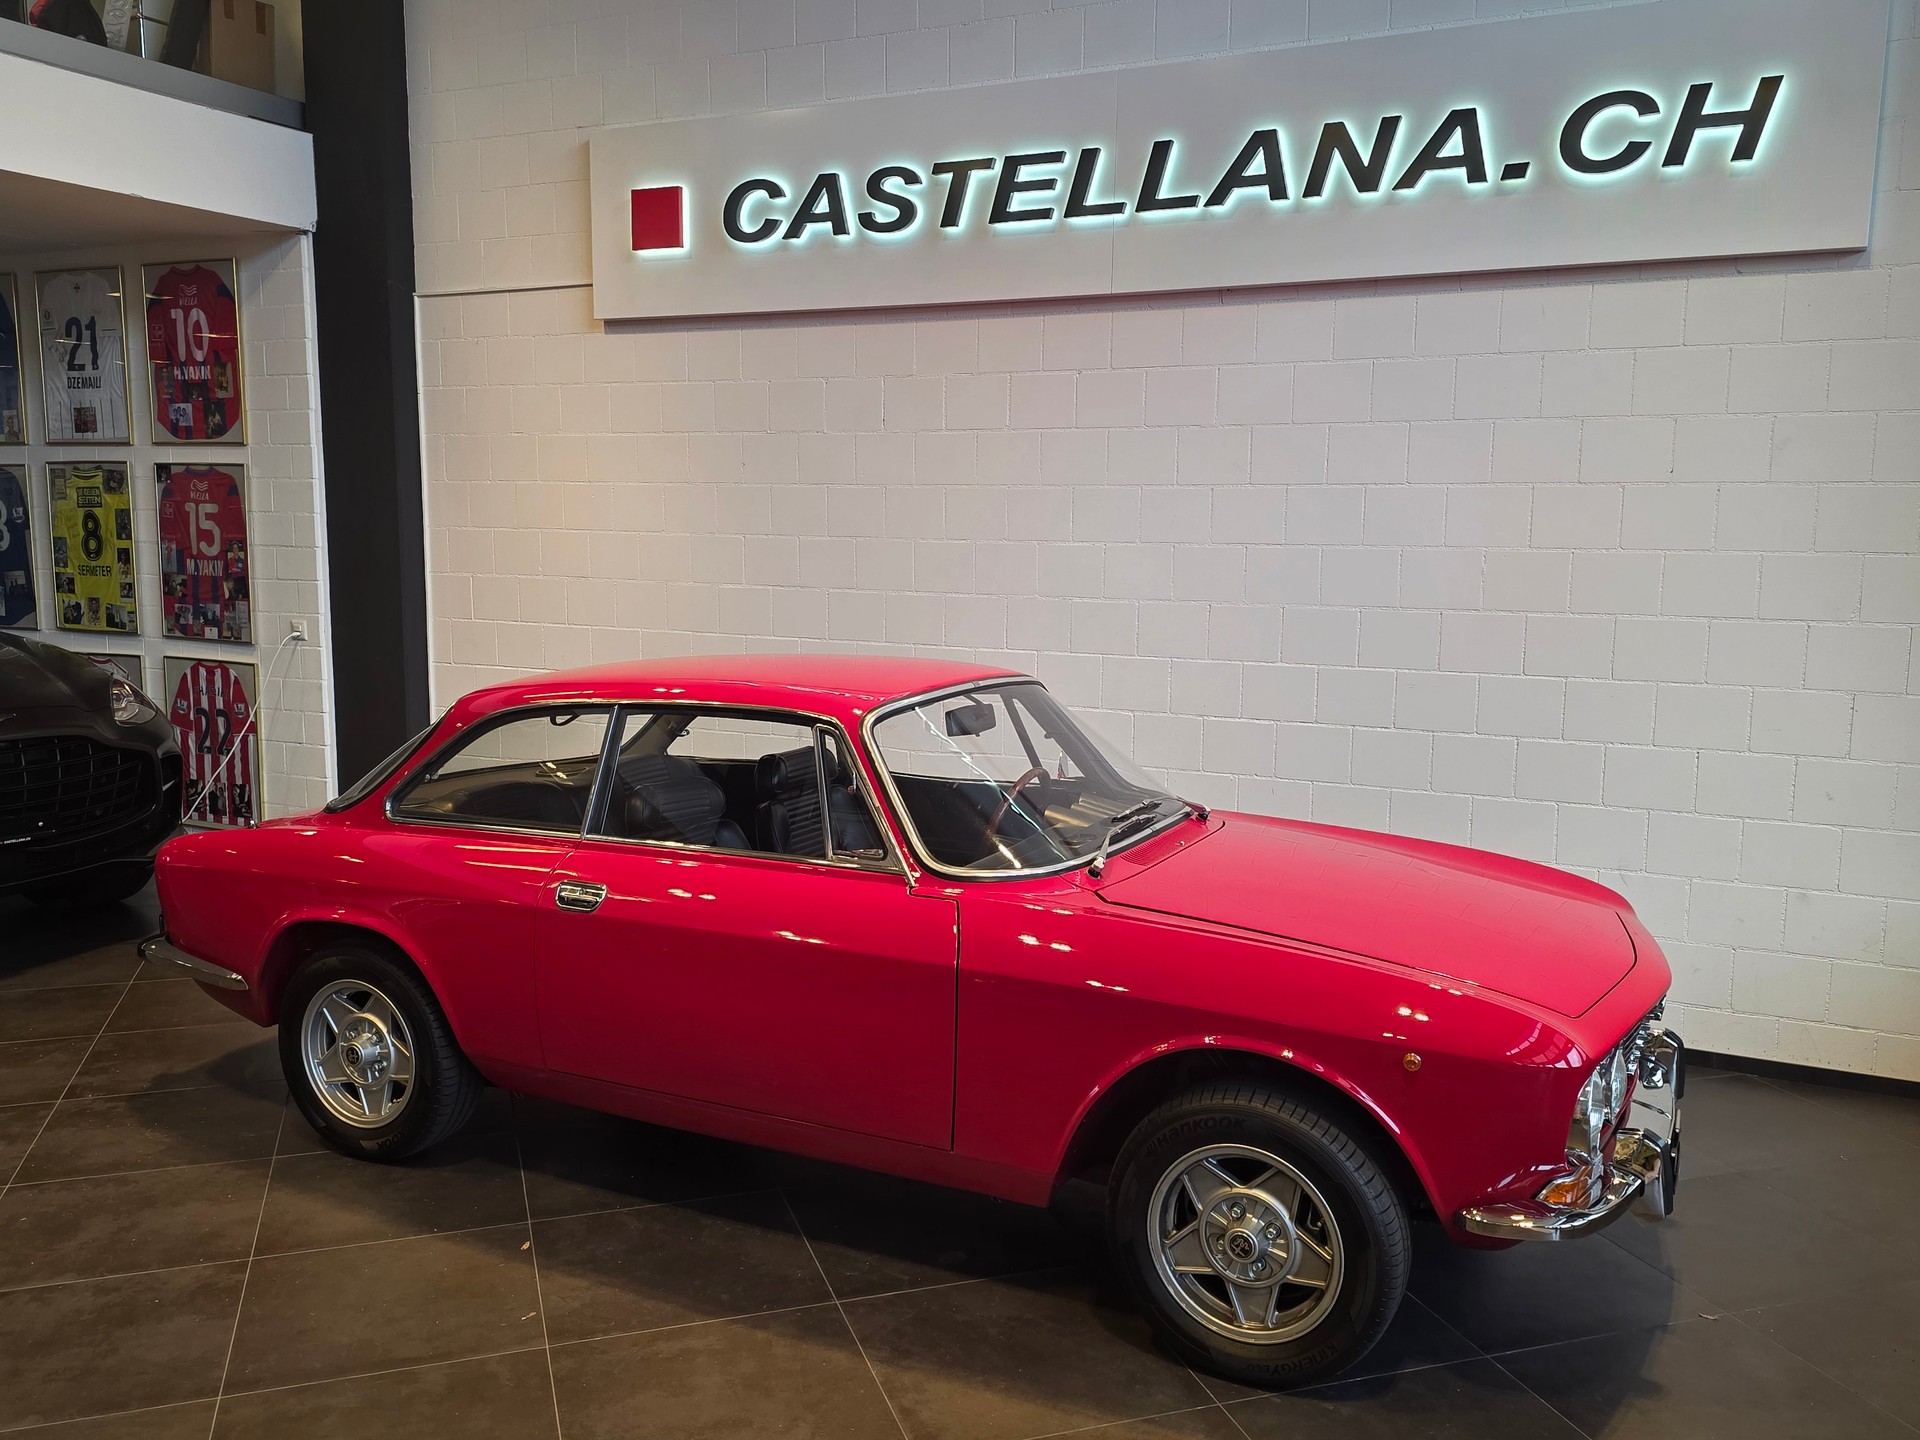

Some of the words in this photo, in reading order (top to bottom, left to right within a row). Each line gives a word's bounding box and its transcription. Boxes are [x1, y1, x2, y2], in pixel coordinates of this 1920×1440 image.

[722, 75, 1785, 243] CASTELLANA.CH
[64, 316, 99, 371] 21
[170, 307, 210, 362] 10
[67, 376, 102, 389] DZEMAILI
[81, 509, 104, 562] 8
[184, 502, 221, 557] 15
[77, 565, 112, 577] SERMETER
[195, 707, 232, 756] 22
